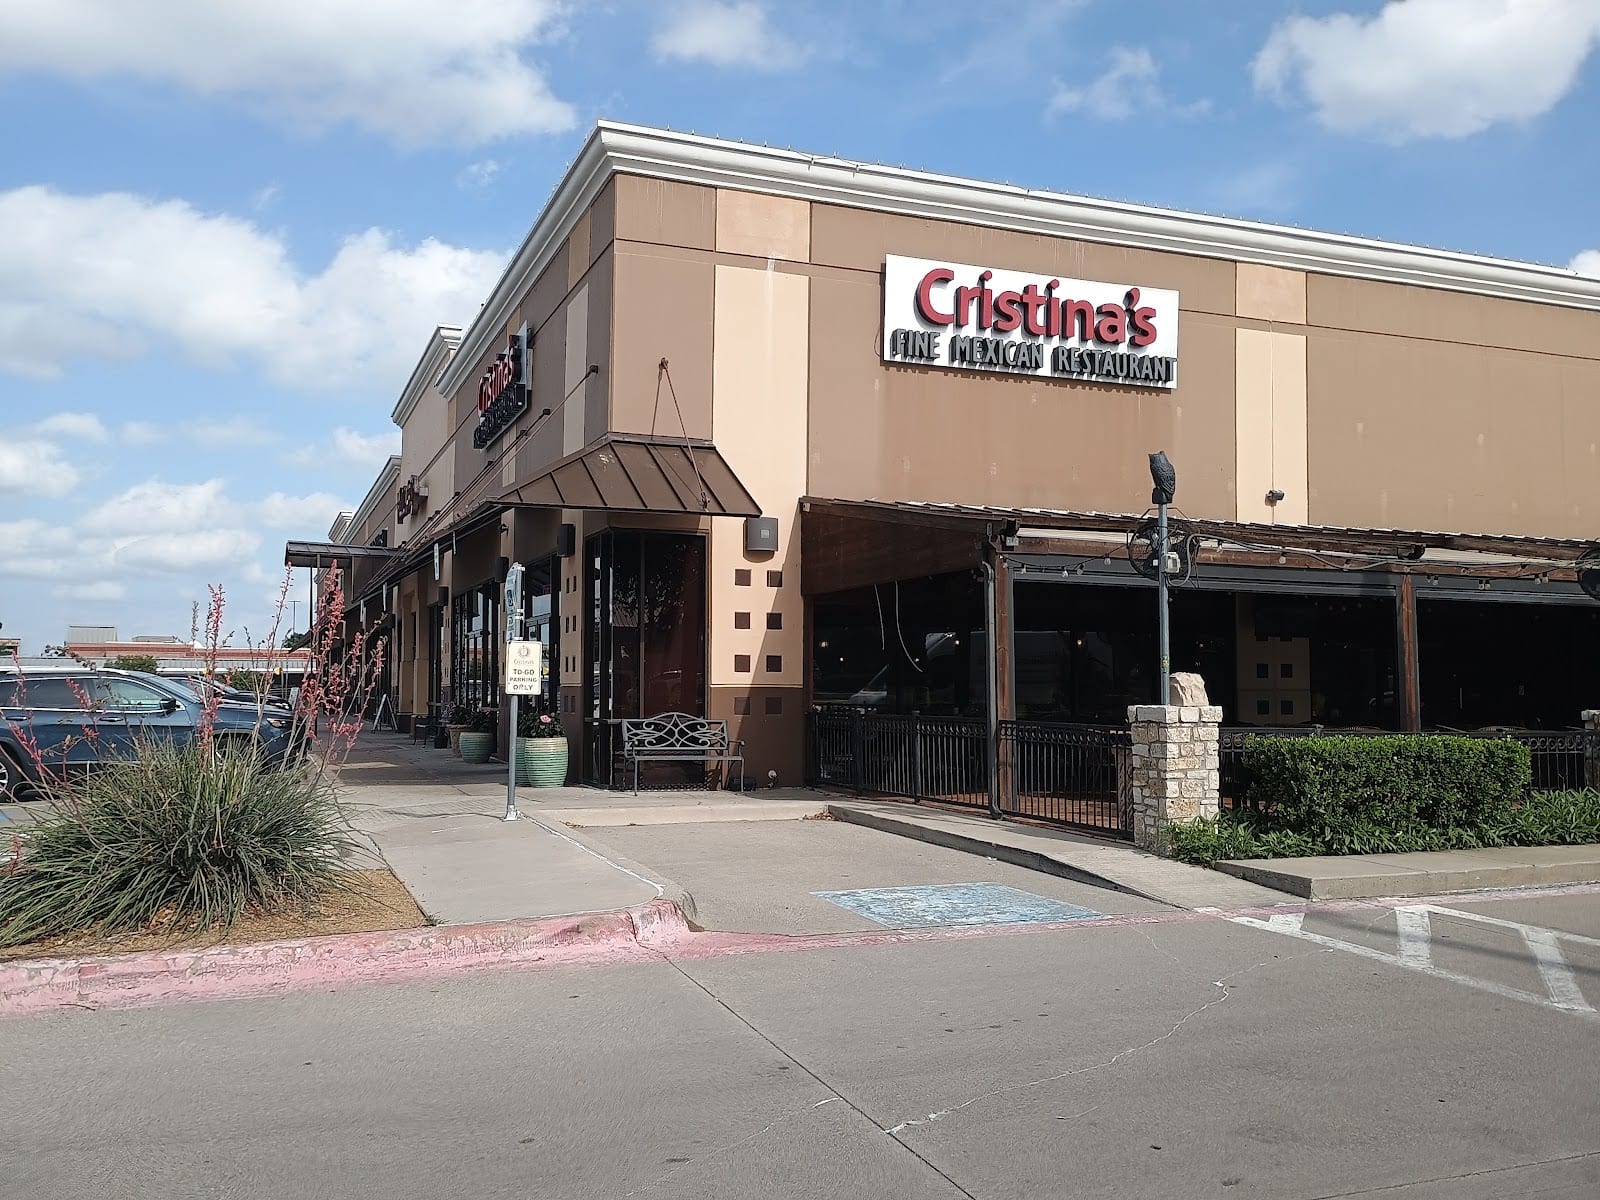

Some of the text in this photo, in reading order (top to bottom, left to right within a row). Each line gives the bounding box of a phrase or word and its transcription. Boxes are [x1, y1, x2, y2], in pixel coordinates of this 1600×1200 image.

[917, 268, 1157, 347] Cristina's
[893, 329, 1178, 382] FINE MEXICAN RESTAURANT
